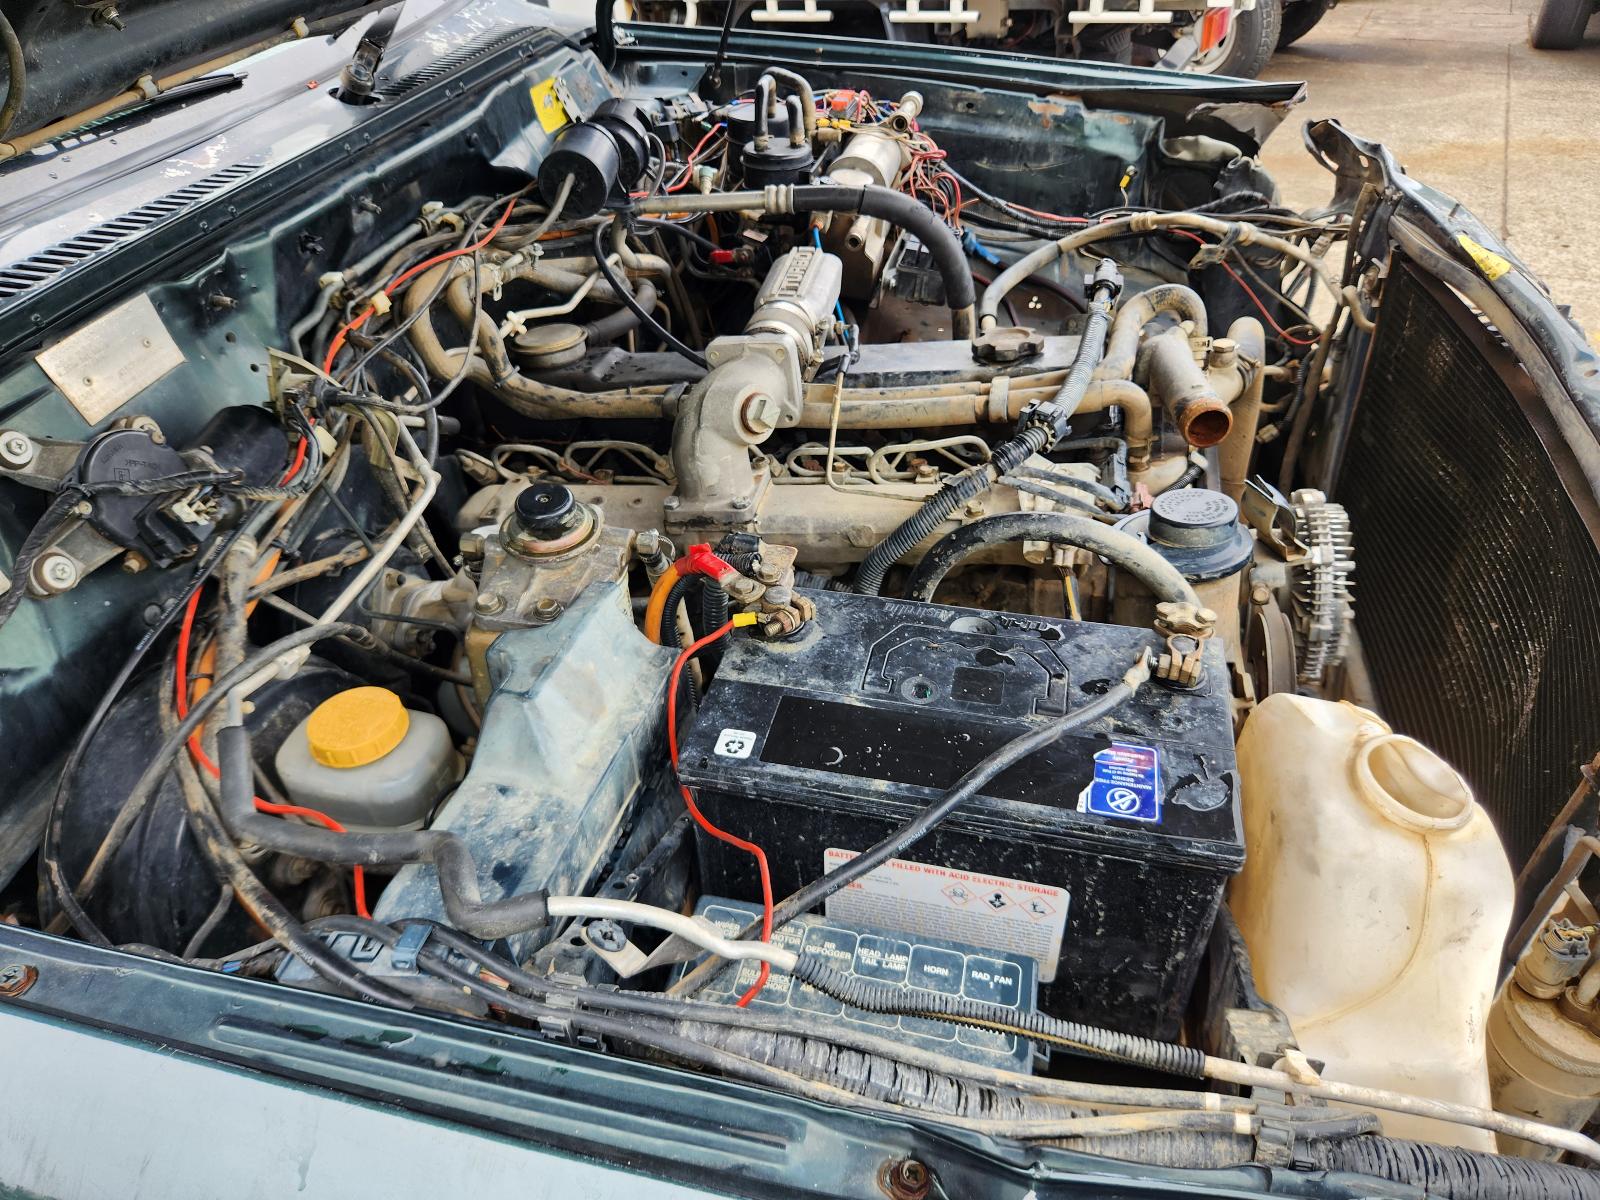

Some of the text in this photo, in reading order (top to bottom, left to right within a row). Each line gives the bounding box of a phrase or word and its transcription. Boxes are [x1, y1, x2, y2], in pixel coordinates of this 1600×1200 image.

[885, 603, 955, 621] Australia
[1110, 780, 1152, 790] MAINTENANCE
[892, 861, 921, 871] FILLED
[923, 867, 946, 877] WITH
[949, 872, 969, 881] ACID
[972, 876, 1014, 888] ELECTRIC
[1016, 884, 1058, 896] STORAGE
[805, 945, 852, 960] DEFOGGER
[824, 942, 836, 950] RR
[858, 948, 908, 962] HEAD LAMP
[861, 957, 906, 971] TAIL LAMP
[923, 964, 949, 976] HORN
[971, 971, 1013, 986] RAD FAN
[989, 981, 994, 989] 1
